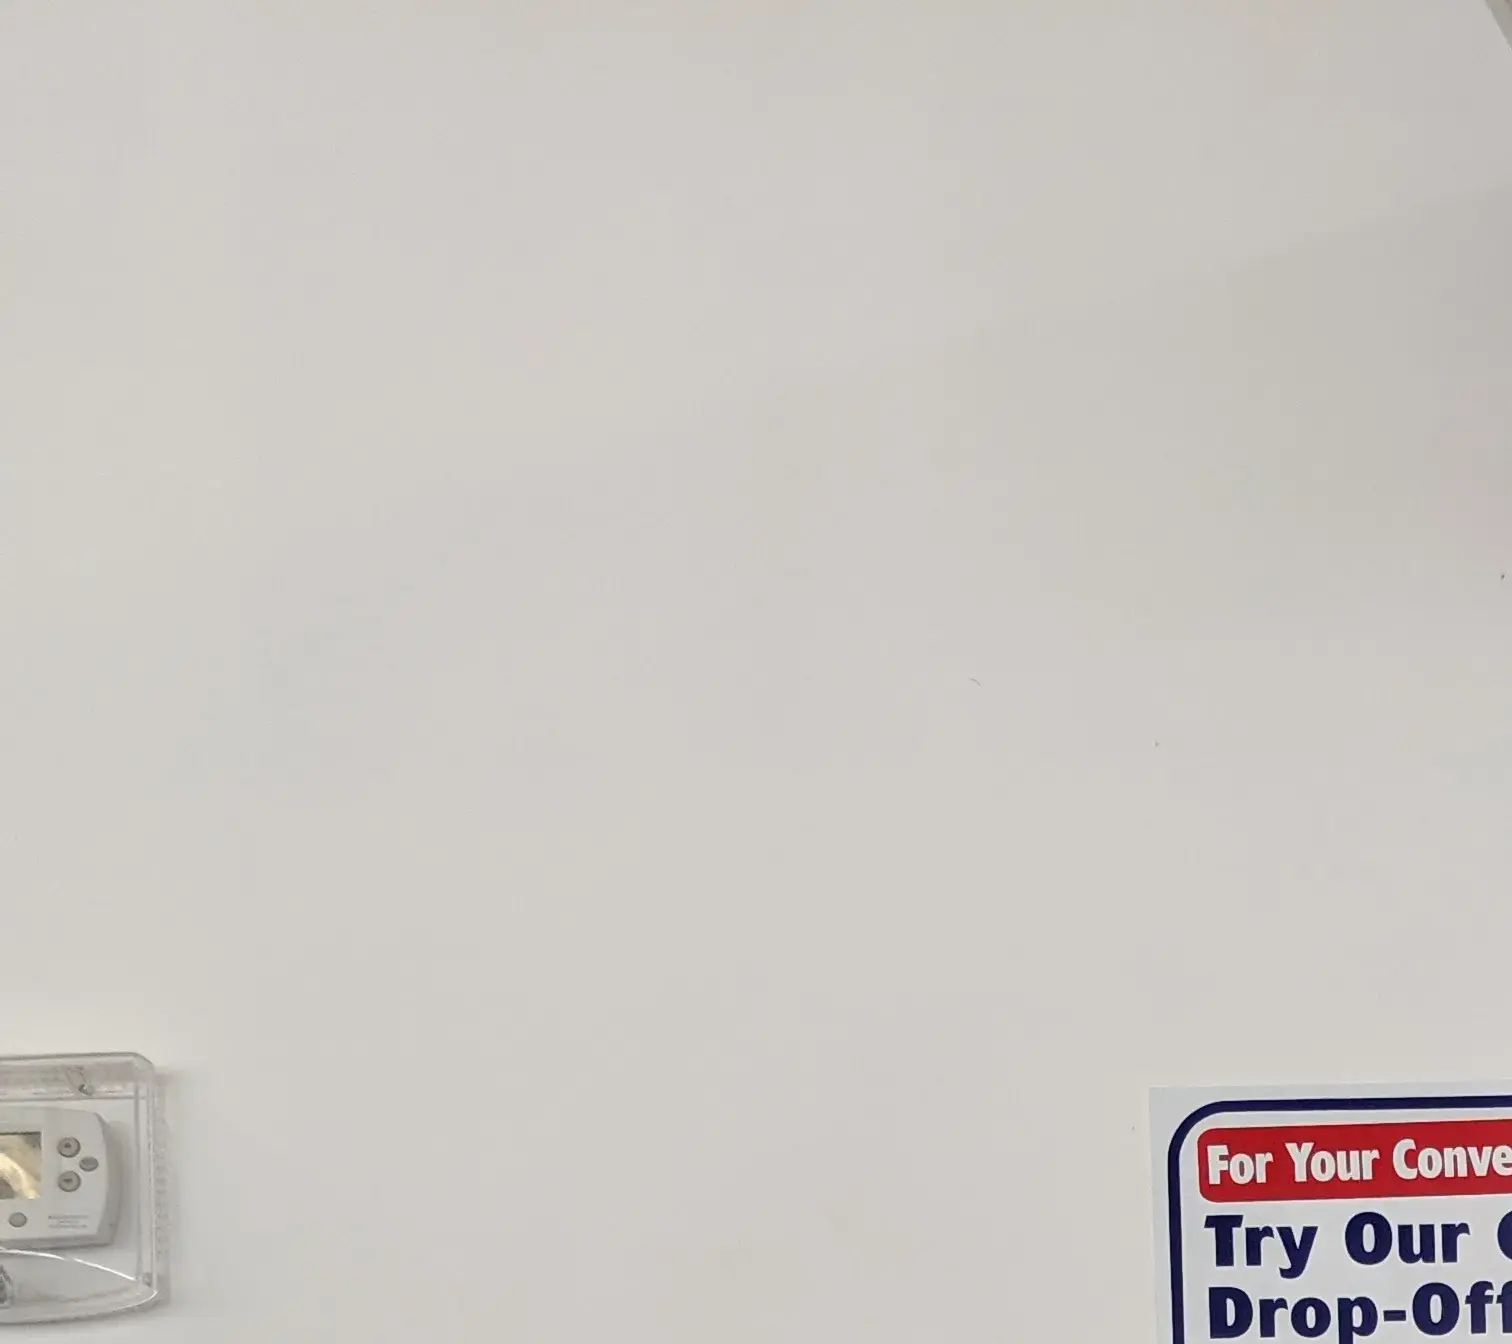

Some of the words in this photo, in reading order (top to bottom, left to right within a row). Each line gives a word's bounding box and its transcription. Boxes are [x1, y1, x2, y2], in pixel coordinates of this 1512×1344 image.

[1206, 1143, 1274, 1186] For
[1285, 1141, 1380, 1182] Your
[1204, 1213, 1318, 1279] Try
[1344, 1211, 1471, 1265] Our
